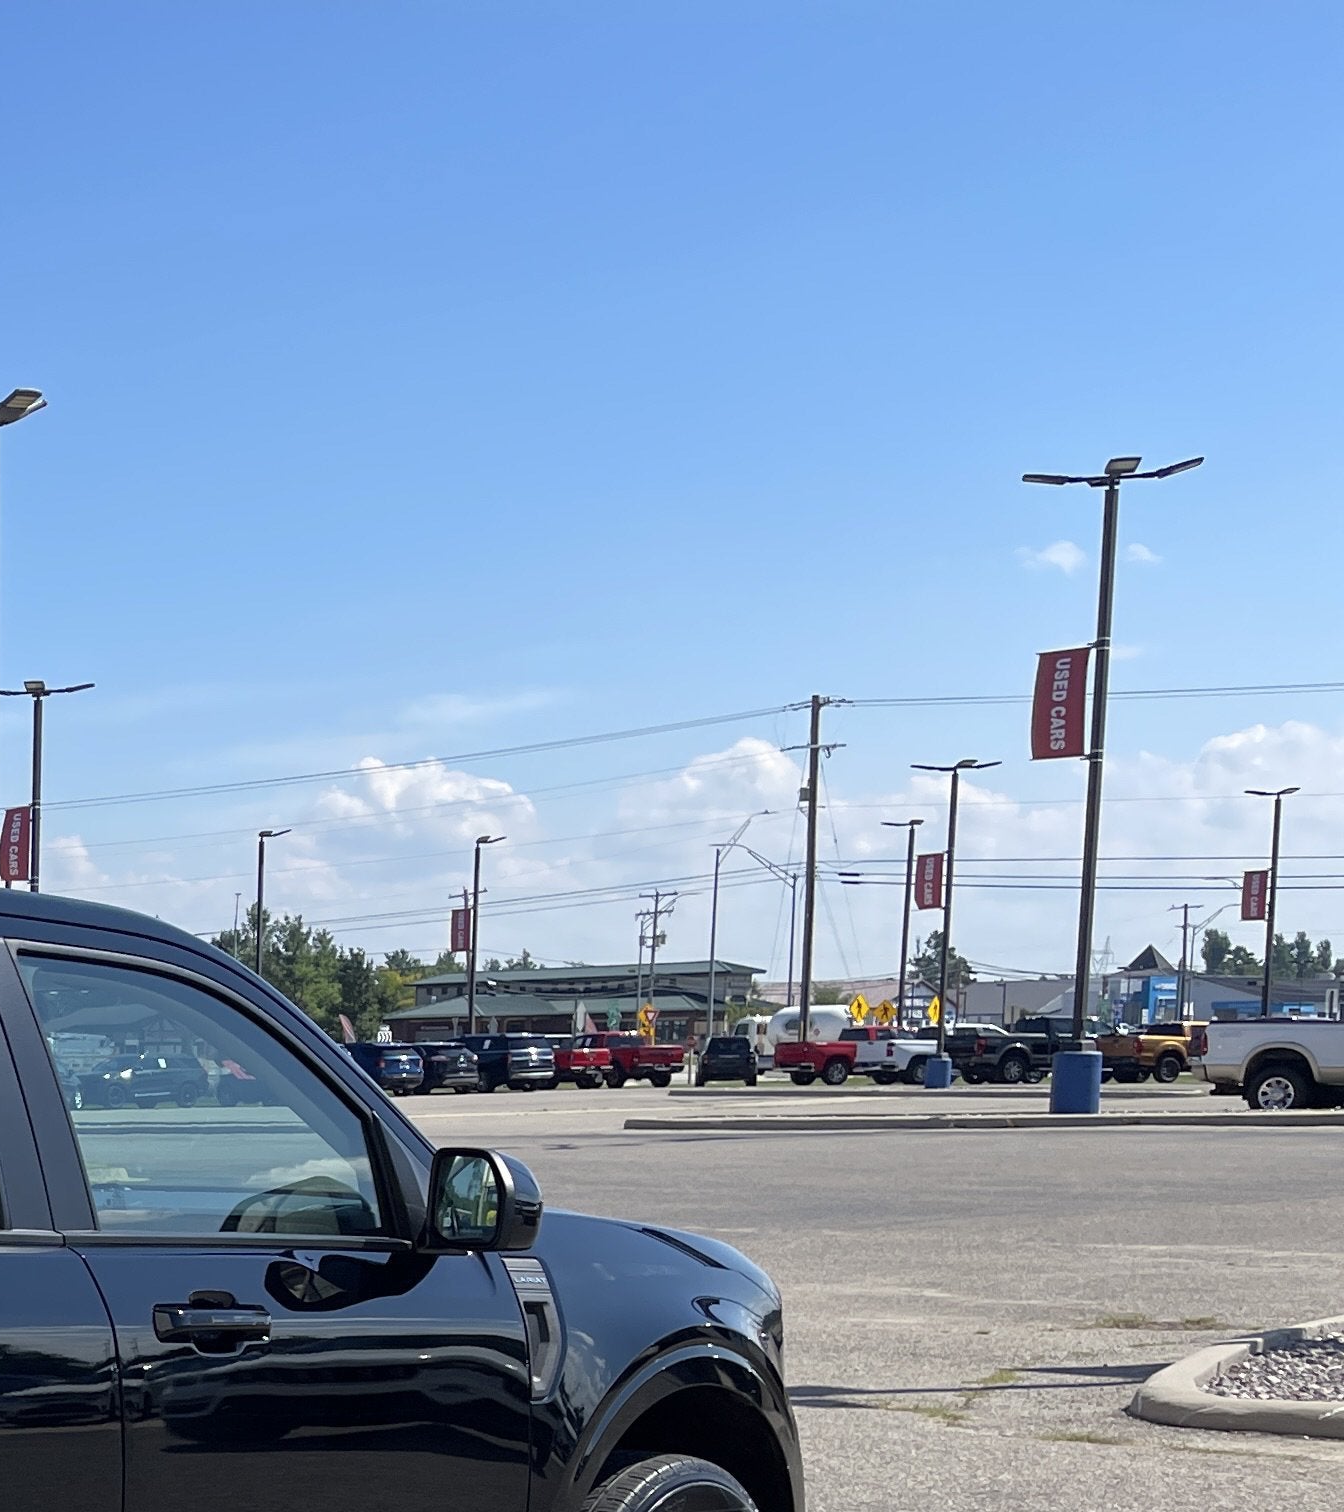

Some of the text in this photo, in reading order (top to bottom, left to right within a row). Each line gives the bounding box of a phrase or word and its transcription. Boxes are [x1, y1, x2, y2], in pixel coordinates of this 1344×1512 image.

[1050, 657, 1072, 751] USED CARS
[8, 812, 22, 876] USED CARS
